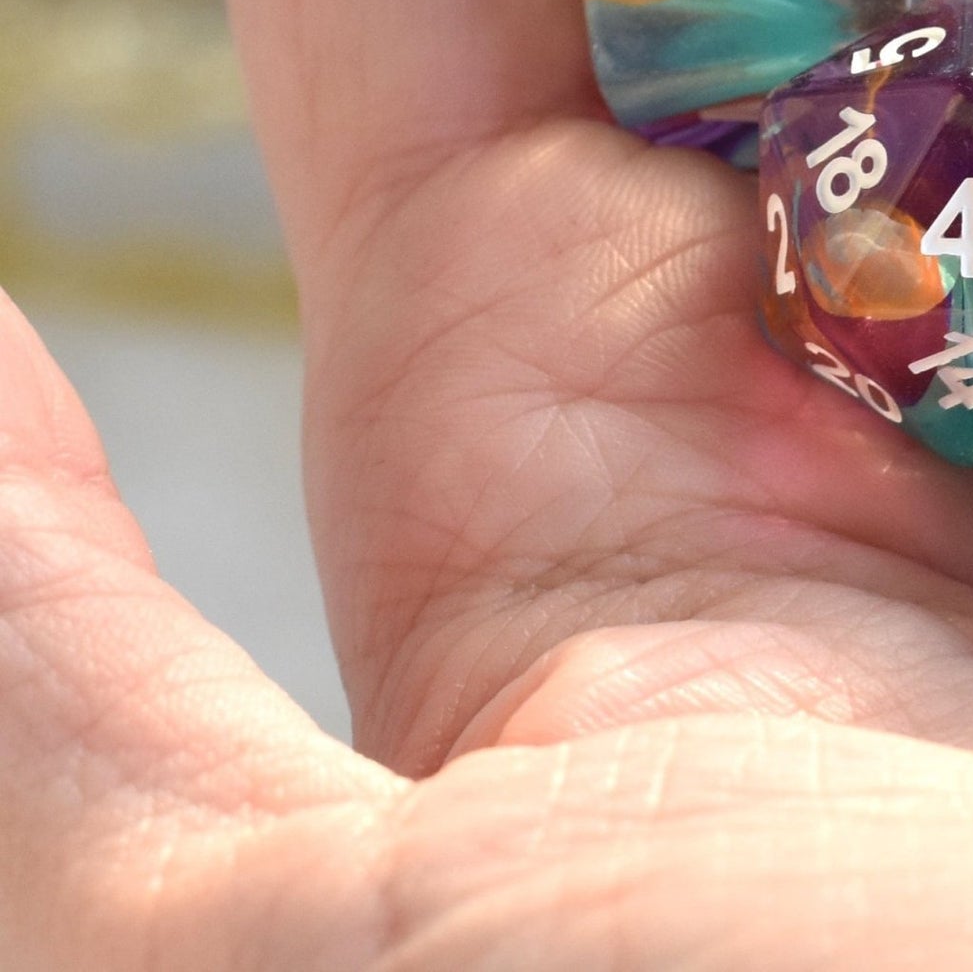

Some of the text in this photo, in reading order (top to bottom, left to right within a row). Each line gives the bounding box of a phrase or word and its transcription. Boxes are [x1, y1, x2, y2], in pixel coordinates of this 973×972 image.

[850, 26, 947, 75] 5
[806, 106, 888, 215] 18
[766, 193, 796, 296] 2
[804, 341, 903, 424] 20
